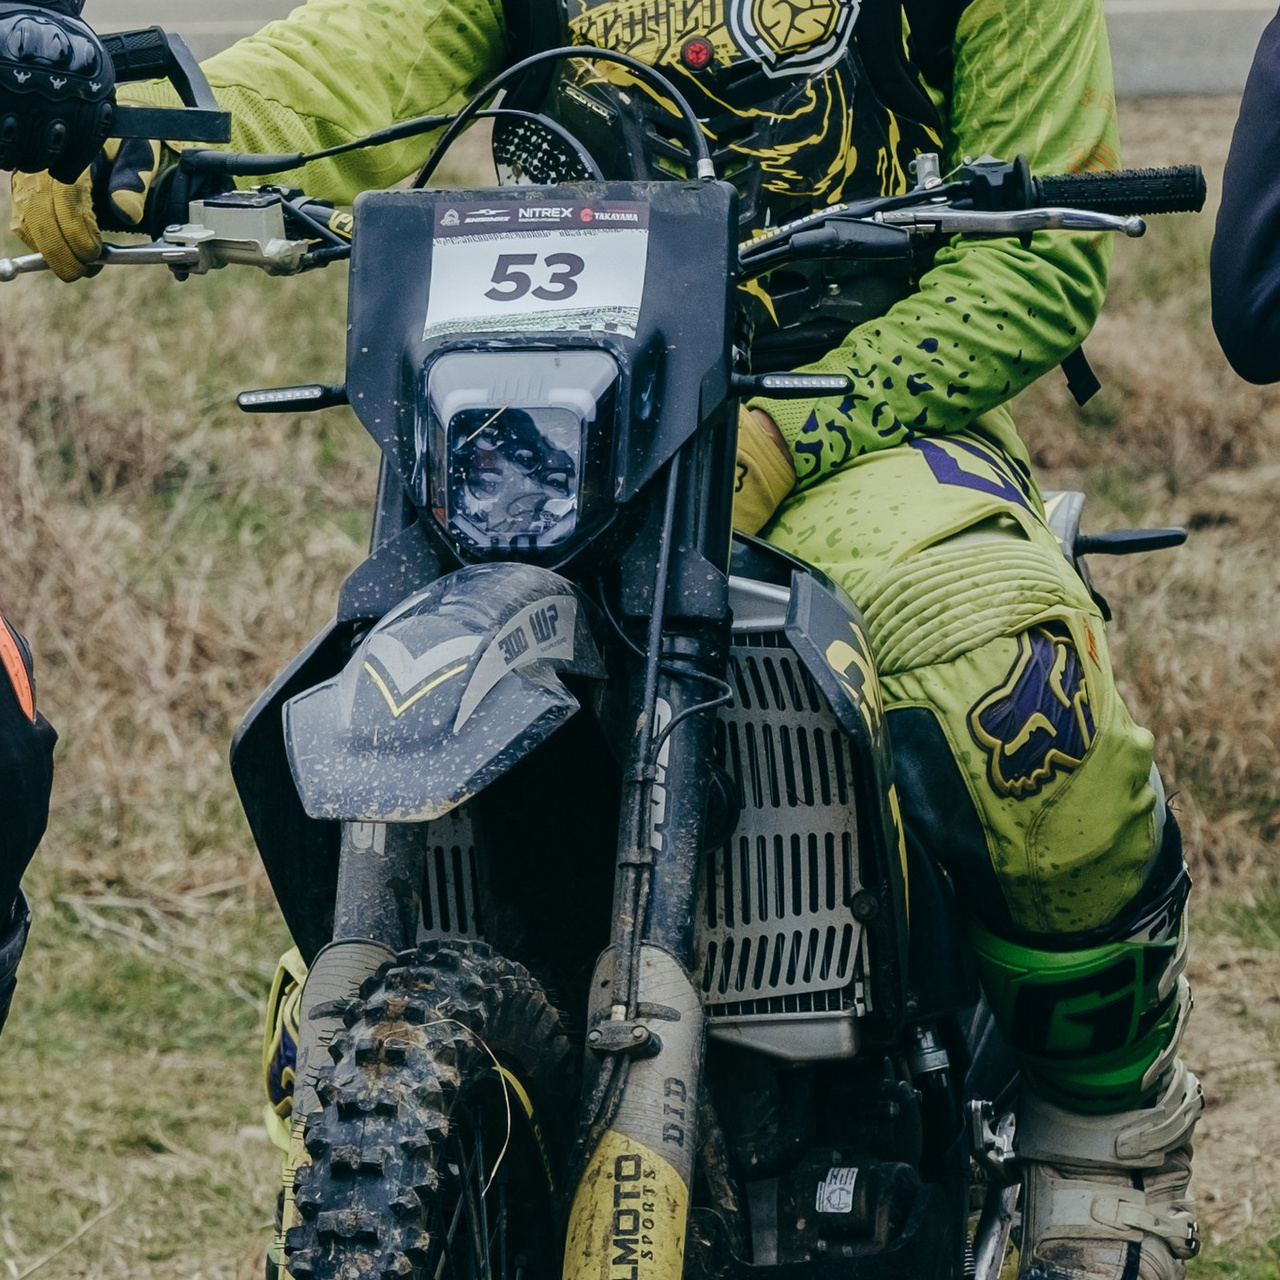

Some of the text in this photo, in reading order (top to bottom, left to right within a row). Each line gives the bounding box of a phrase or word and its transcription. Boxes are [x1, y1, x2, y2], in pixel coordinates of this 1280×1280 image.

[518, 207, 574, 218] NITREX
[593, 212, 639, 222] TAKAYAMA
[483, 252, 586, 302] 53
[498, 625, 530, 666] 300
[662, 1076, 687, 1148] DID
[640, 1168, 658, 1262] SPORTS
